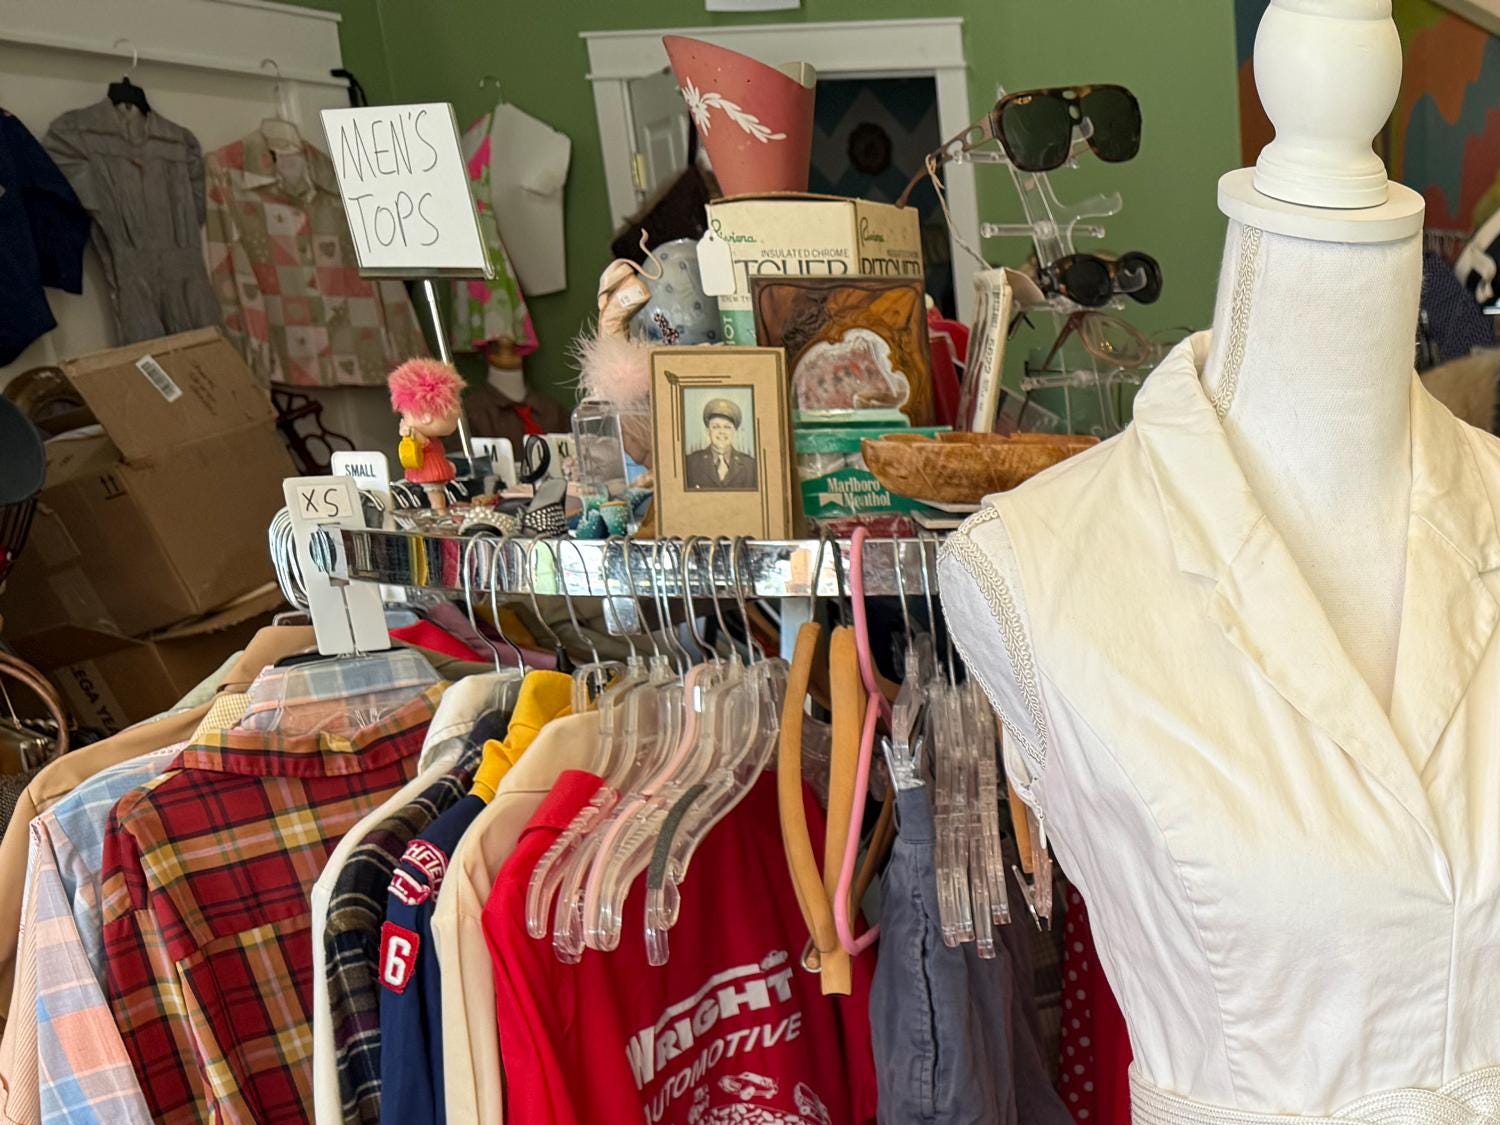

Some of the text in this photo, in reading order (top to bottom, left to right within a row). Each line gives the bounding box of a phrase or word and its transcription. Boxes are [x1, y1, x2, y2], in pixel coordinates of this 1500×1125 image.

[340, 109, 438, 182] MEN'S
[347, 190, 440, 254] TOPS
[760, 248, 849, 259] INSULATED CHROME
[344, 463, 377, 479] SMALL
[826, 477, 881, 493] Marlboro
[300, 488, 339, 518] XS
[383, 935, 412, 986] 6
[625, 967, 794, 1091] WRIGHT
